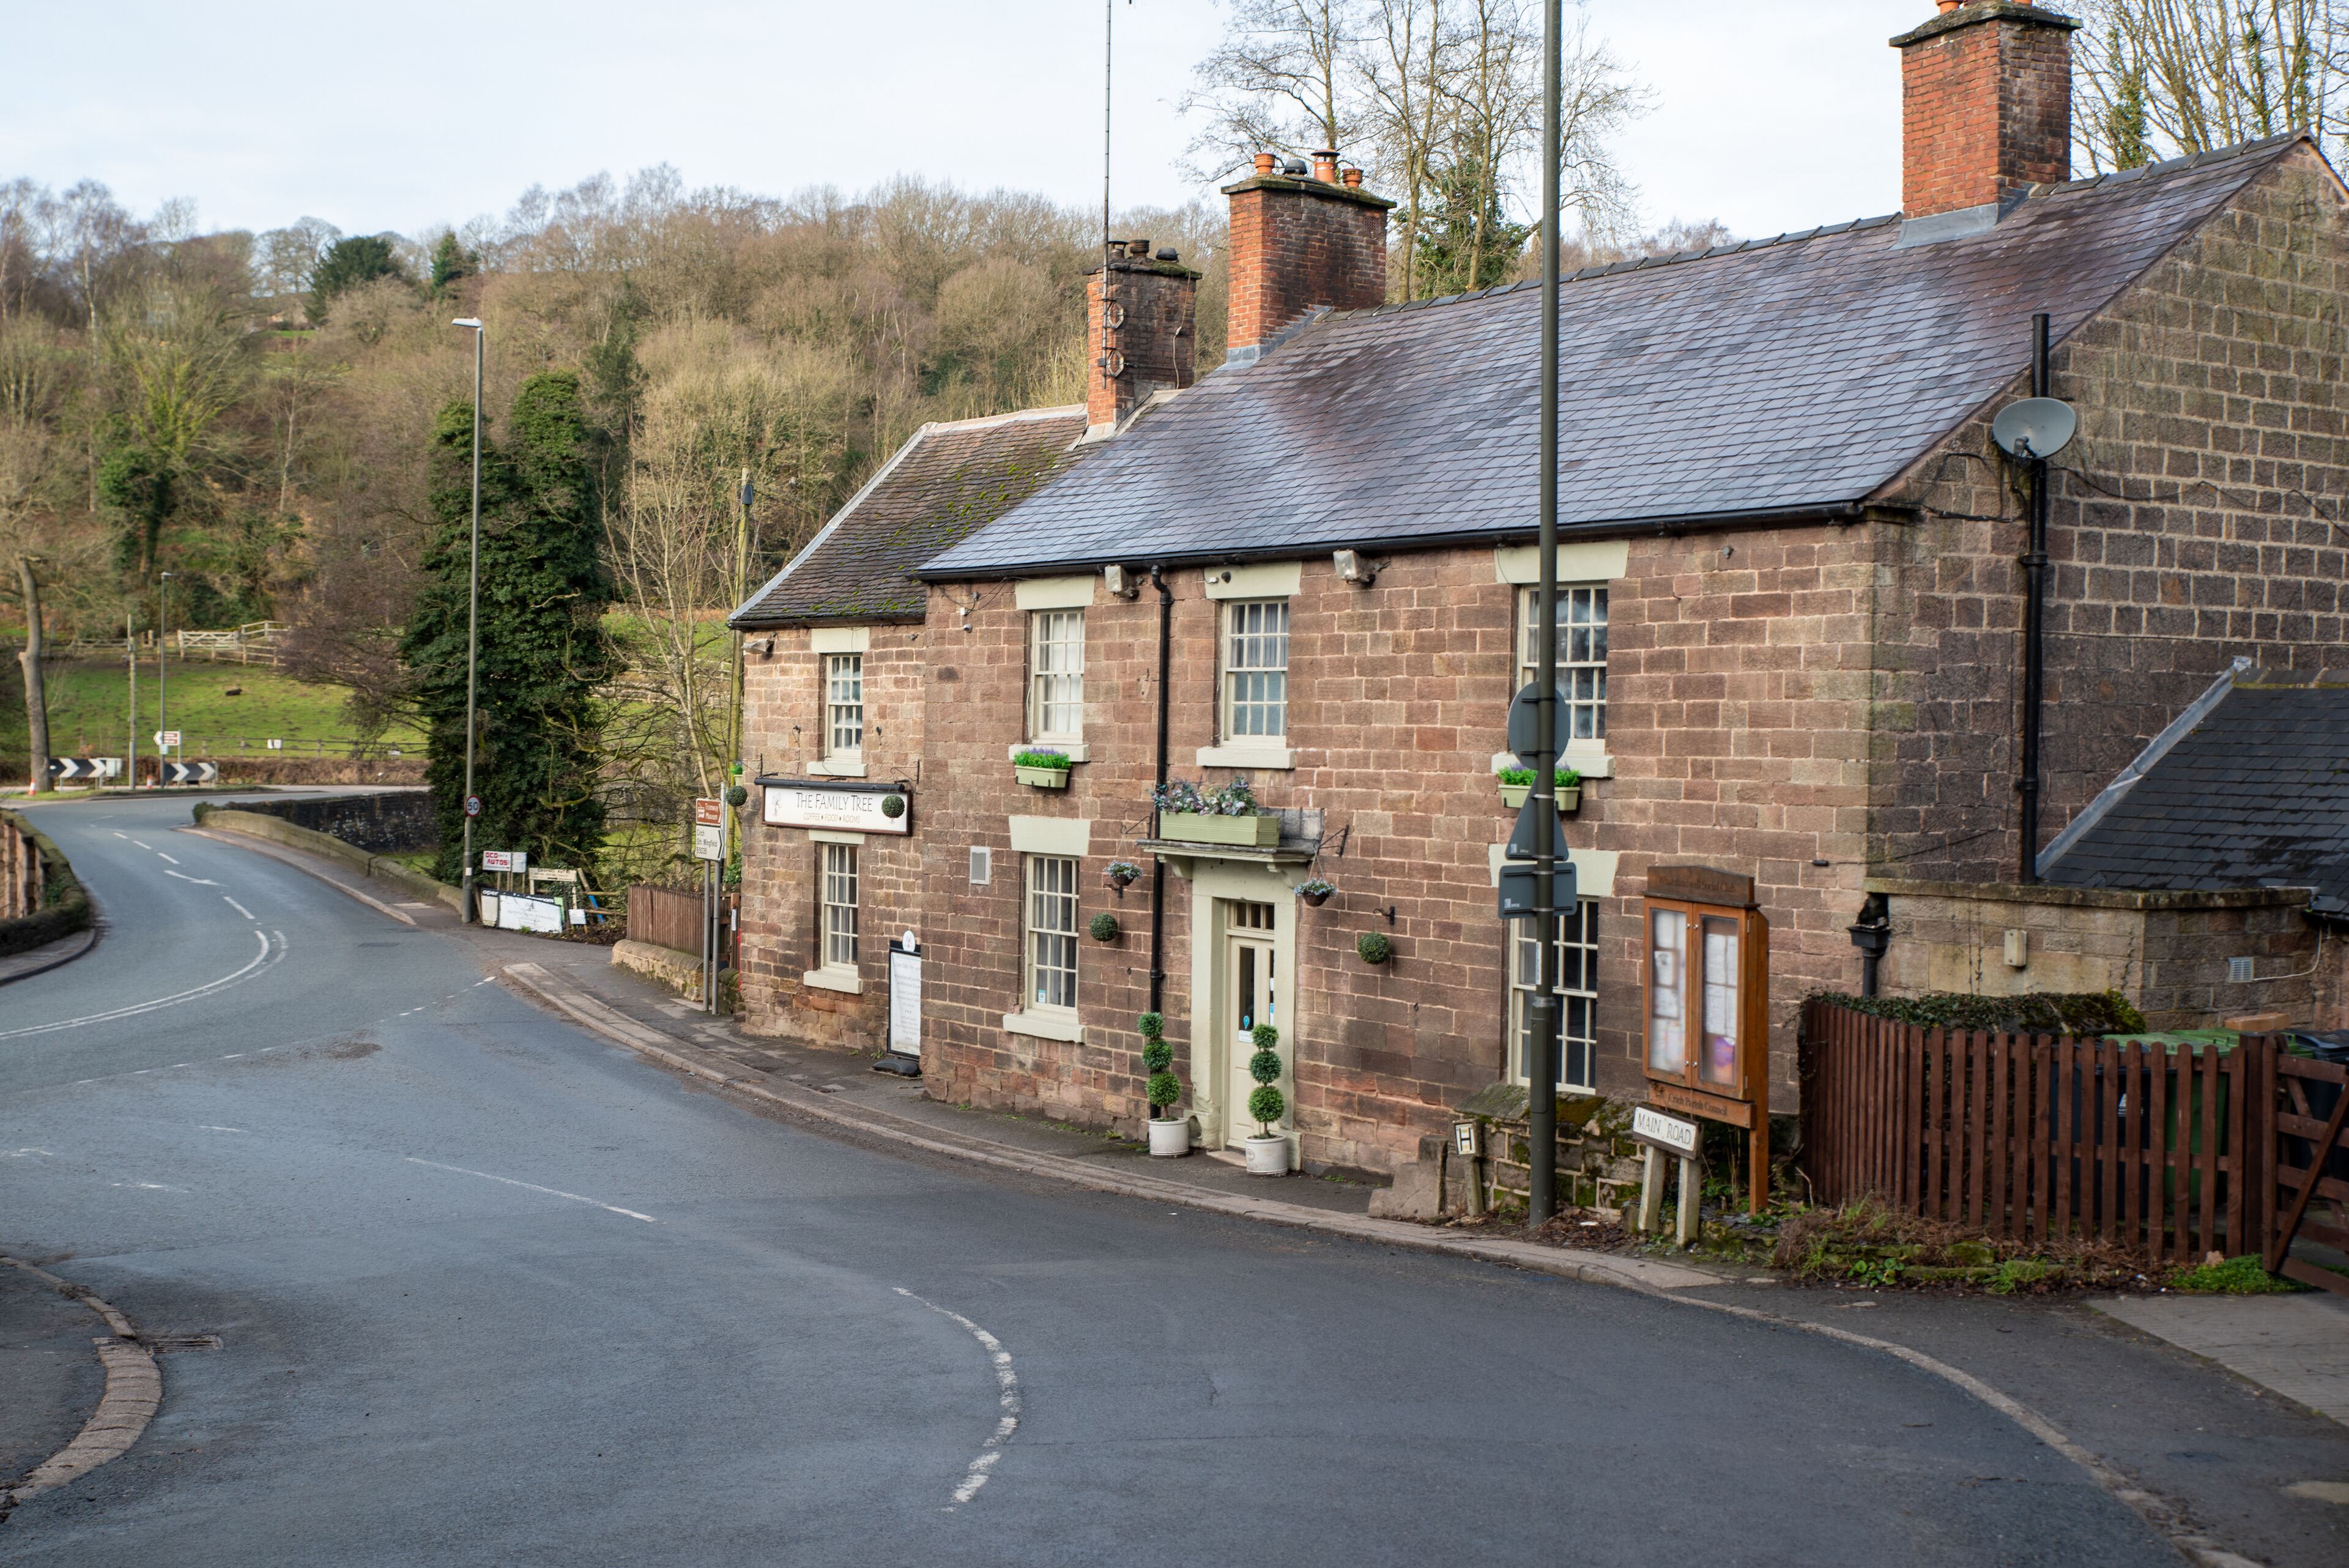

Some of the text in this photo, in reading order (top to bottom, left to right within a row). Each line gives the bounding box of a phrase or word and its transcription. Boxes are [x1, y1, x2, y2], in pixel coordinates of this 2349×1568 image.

[467, 801, 478, 811] 50
[705, 803, 719, 812] Tramway
[815, 793, 849, 810] FAMILY
[851, 795, 873, 812] TREE
[705, 812, 718, 820] Museum
[803, 812, 861, 823] COFFEE FOOD ROOMS
[703, 839, 718, 848] Wingfield
[1702, 880, 1719, 891] Social
[1721, 880, 1735, 893] Club
[1668, 1093, 1727, 1116] Crich Parish Council
[1636, 1112, 1691, 1145] MAIN ROAD
[1459, 1127, 1472, 1151] H
